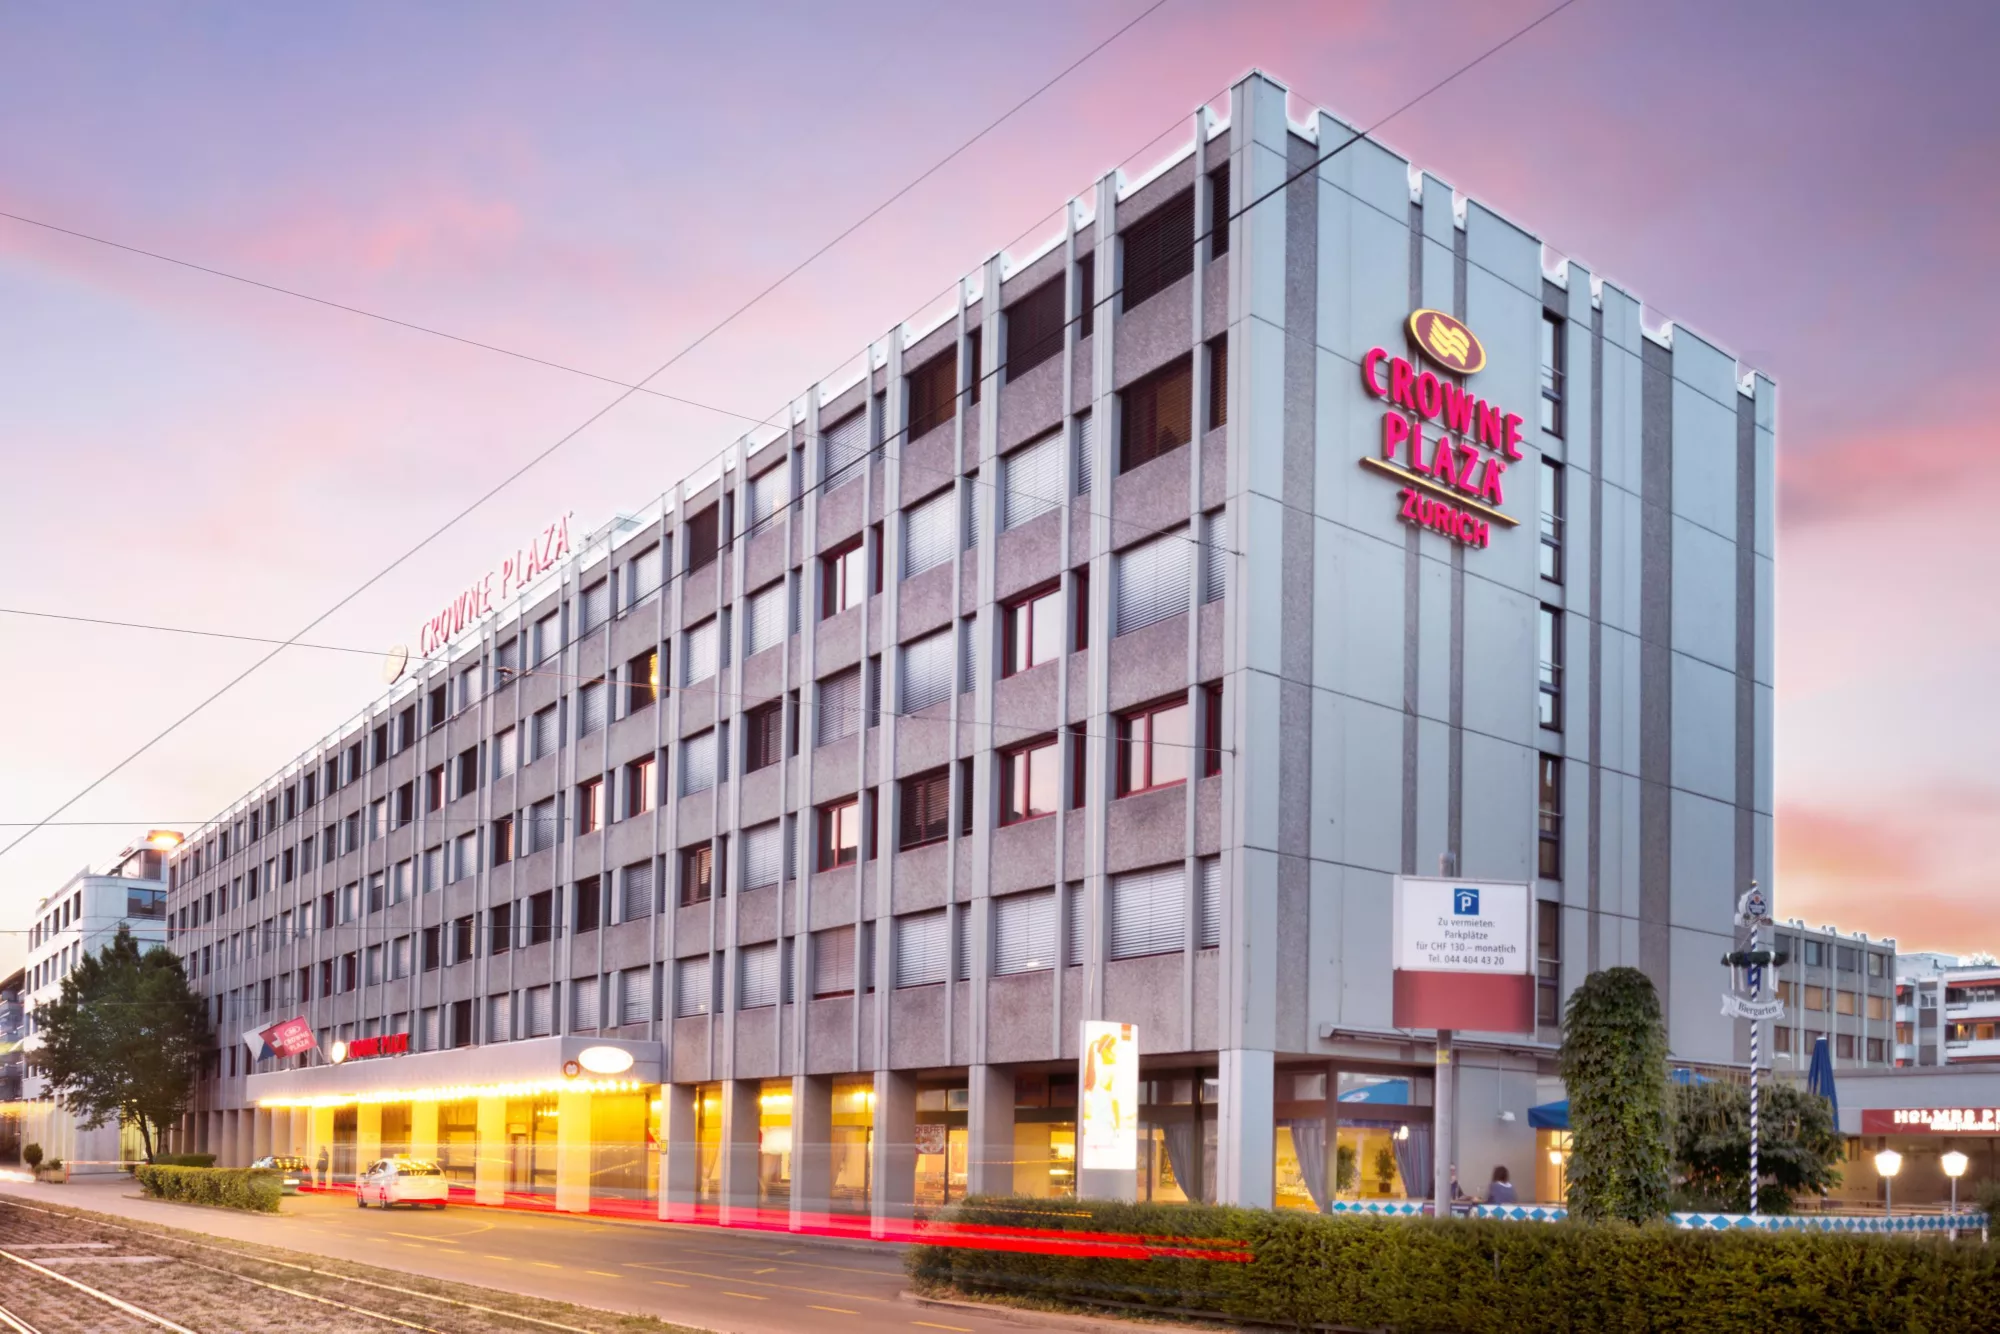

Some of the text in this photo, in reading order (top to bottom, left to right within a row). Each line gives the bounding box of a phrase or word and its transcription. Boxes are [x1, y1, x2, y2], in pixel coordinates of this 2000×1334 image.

[1361, 347, 1523, 461] CROWNE
[1382, 411, 1504, 505] PLAZA
[1400, 487, 1489, 548] ZURICH
[420, 515, 571, 658] CROWNE PLAZA
[1461, 896, 1472, 912] P
[1438, 917, 1496, 928] Zu vermieten:
[1444, 930, 1489, 940] Parkplätze
[1416, 941, 1428, 950] für
[1430, 942, 1448, 951] CHF
[1474, 944, 1517, 953] monatlich
[1428, 954, 1505, 966] Tel. 044 404 43 20
[1738, 1001, 1777, 1017] Biergarten
[288, 1039, 310, 1051] PLAZA
